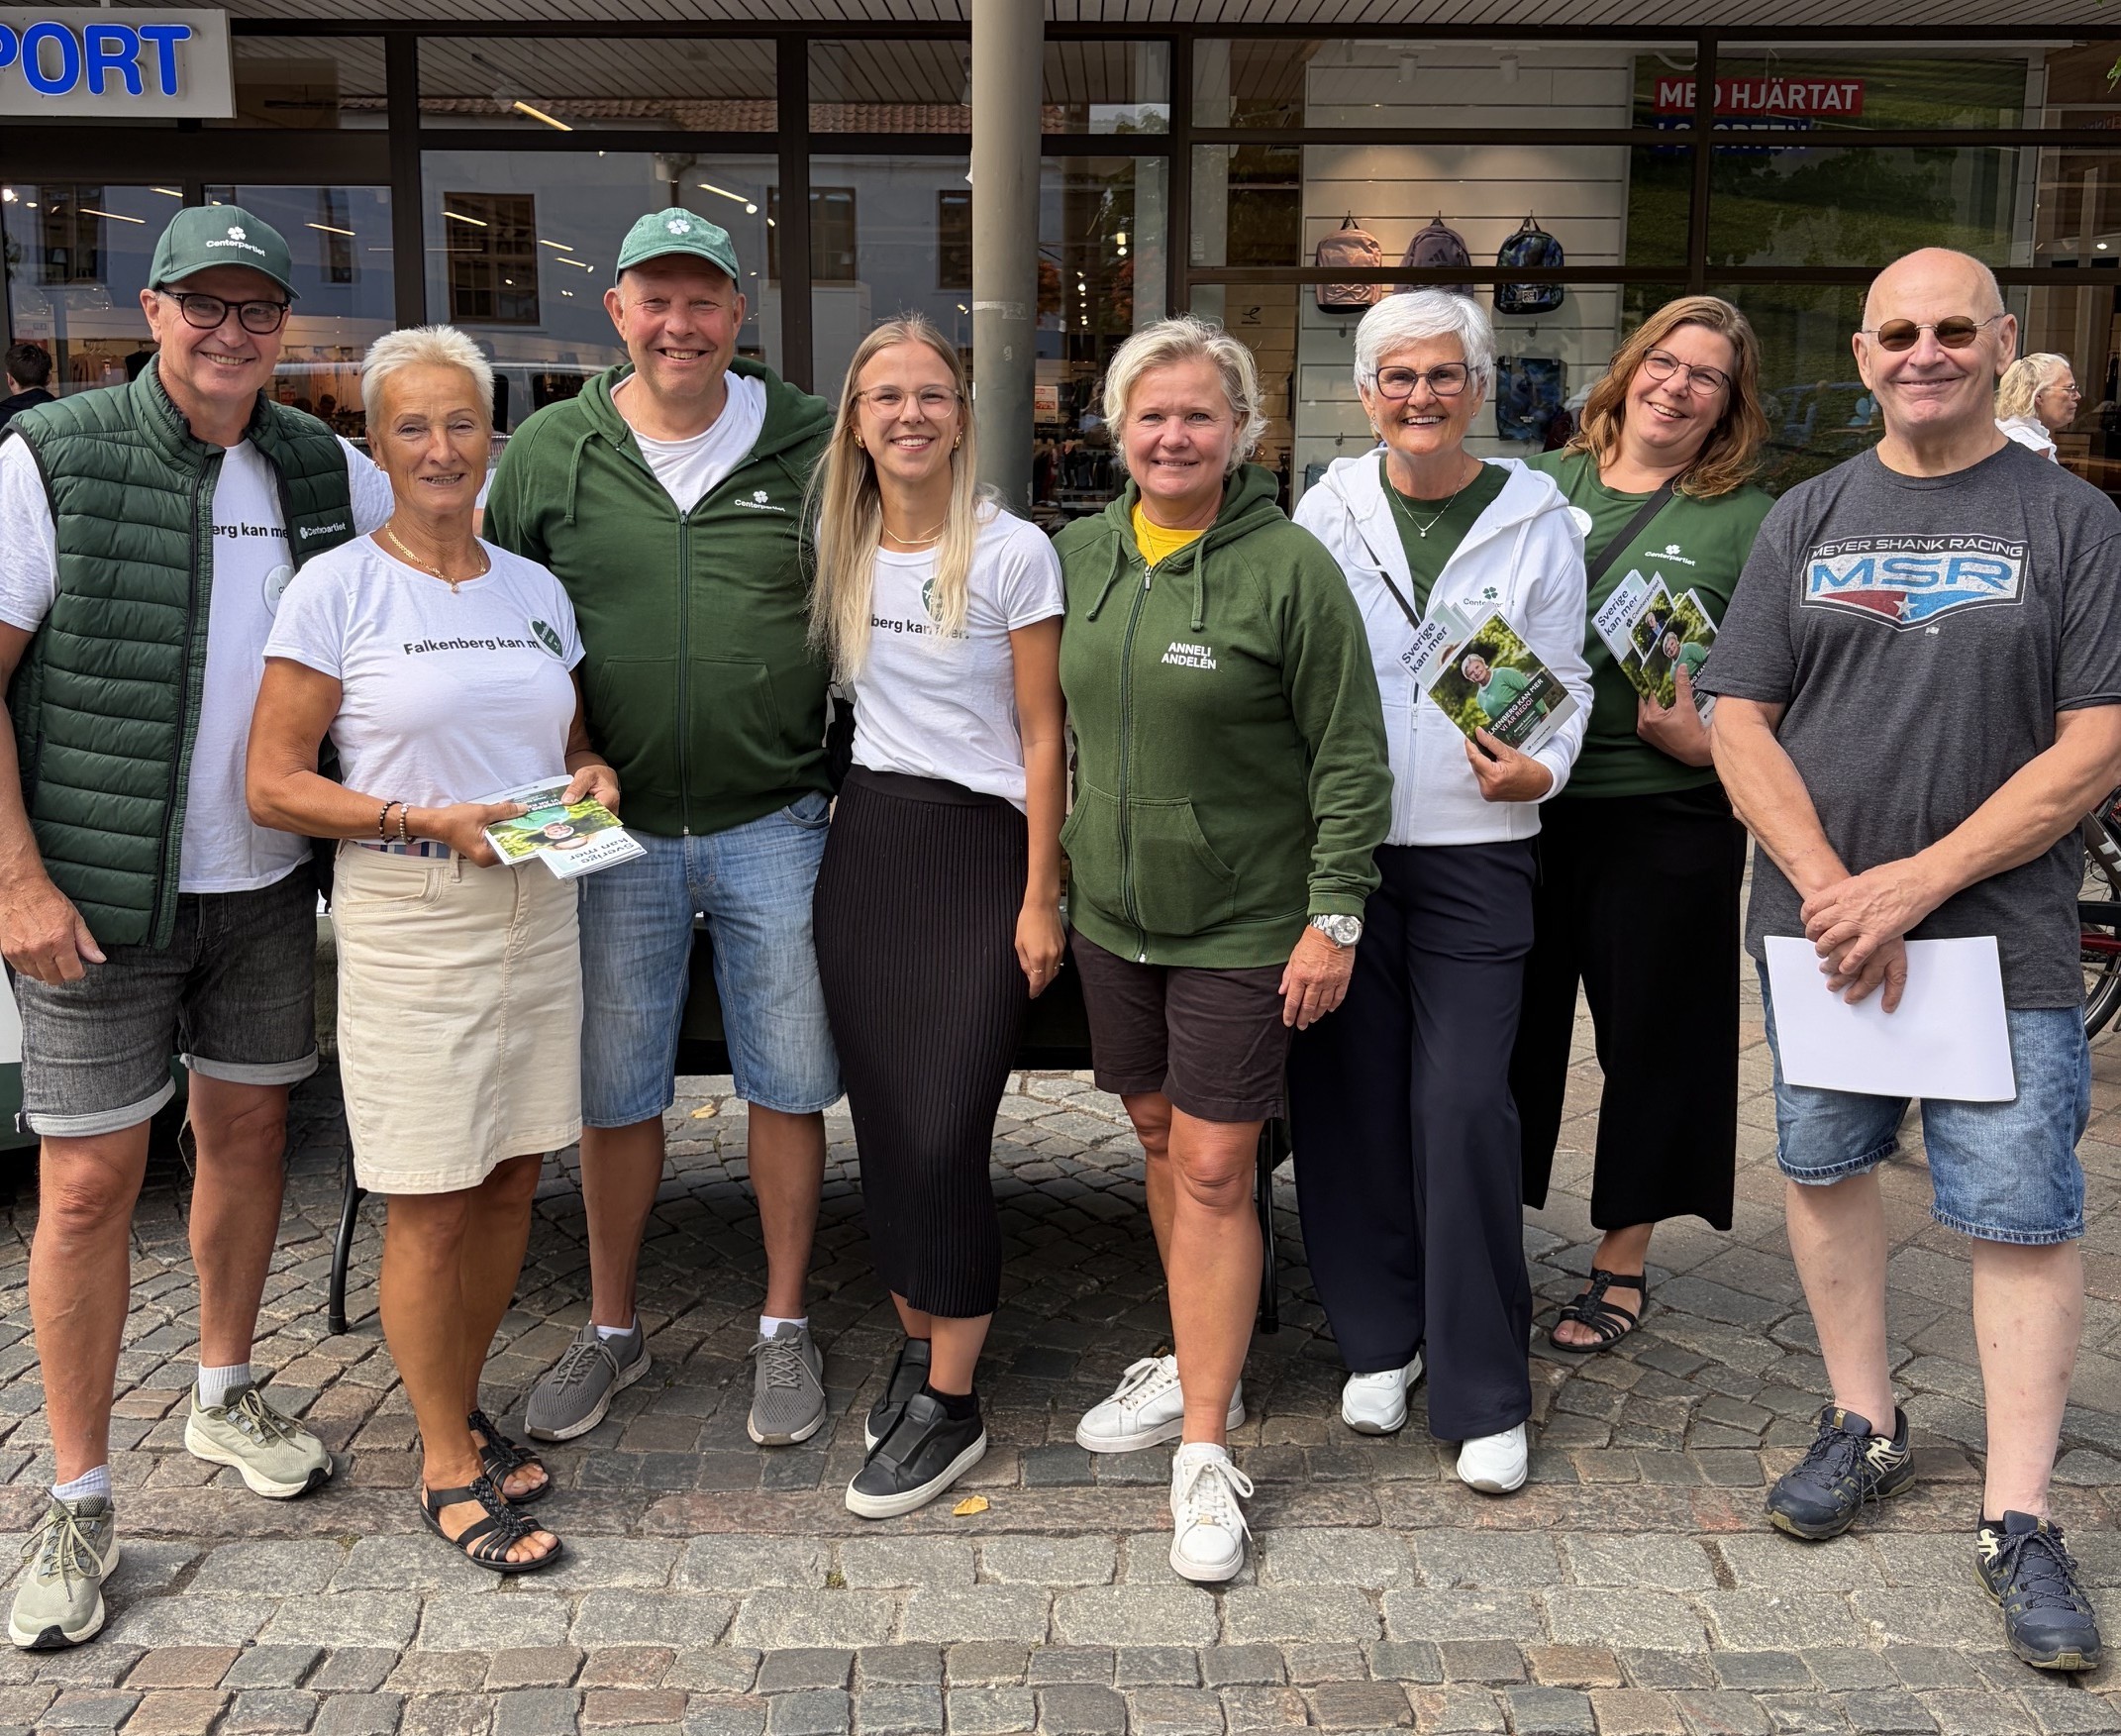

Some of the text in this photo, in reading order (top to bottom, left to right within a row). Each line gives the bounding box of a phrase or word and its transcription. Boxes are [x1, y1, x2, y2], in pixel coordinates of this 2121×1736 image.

[1731, 77, 1859, 110] HJÄRTAT
[206, 240, 265, 256] Centerpartiet
[212, 522, 288, 539] erg kan me
[1644, 551, 1696, 566] Centerpartiet
[1811, 538, 2024, 560] MEYER SHANK RACING
[1811, 557, 2013, 593] MSR
[1597, 589, 1629, 628] Sverige
[1604, 593, 1639, 638] kan mer
[403, 637, 496, 656] Falkenberg
[496, 637, 526, 649] kan
[1168, 642, 1211, 658] ANNELI
[1401, 621, 1436, 664] Sverige
[1410, 625, 1448, 674] kan mer
[1161, 653, 1217, 669] ANDELÉN
[1488, 704, 1518, 736] LKENBERG
